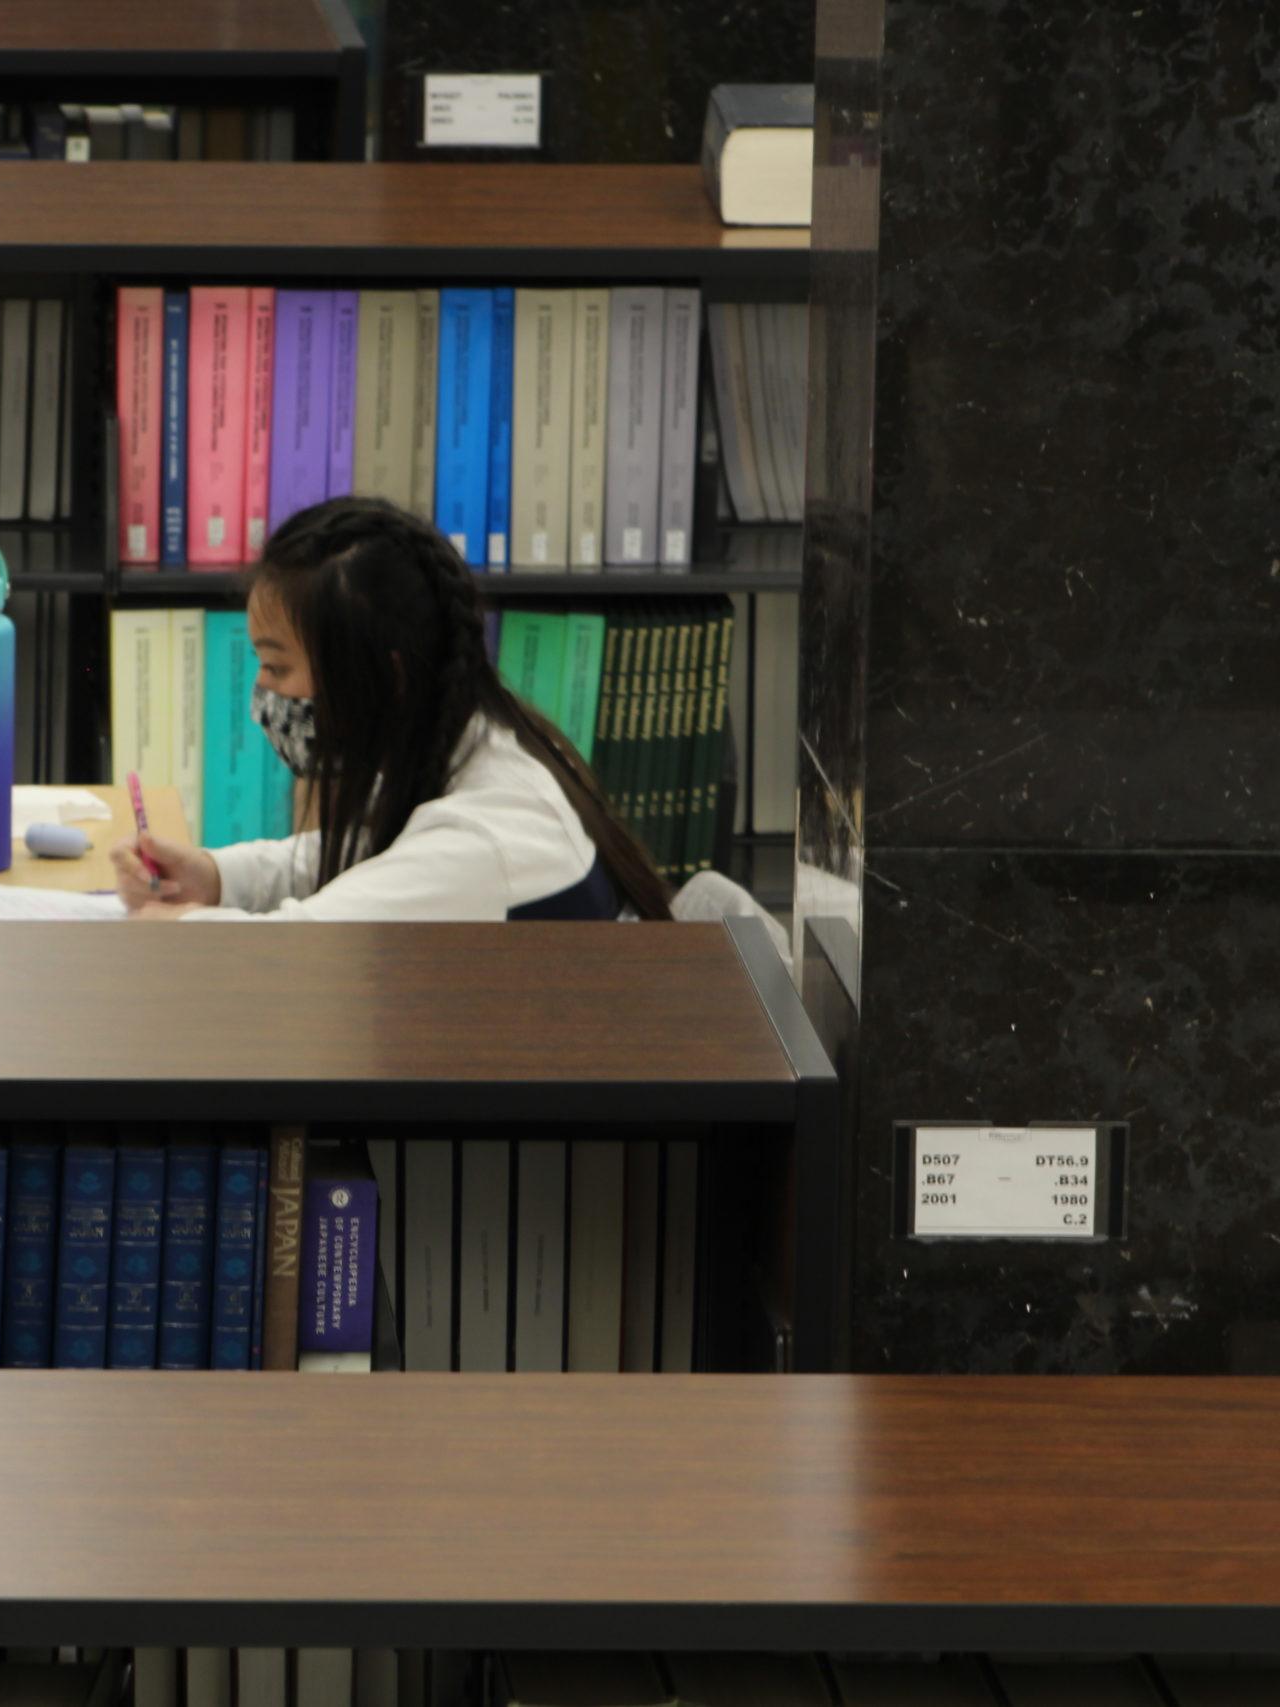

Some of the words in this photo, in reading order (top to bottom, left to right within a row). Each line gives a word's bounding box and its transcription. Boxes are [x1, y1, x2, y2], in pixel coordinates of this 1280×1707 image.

[922, 1154, 960, 1166] D507
[1035, 1155, 1089, 1167] DT56.9
[922, 1174, 955, 1186] .B67
[1054, 1175, 1088, 1187] .B34
[921, 1194, 957, 1205] 2001
[1051, 1195, 1088, 1206] 1980
[334, 1217, 344, 1231] OF
[1063, 1213, 1087, 1225] C.2
[272, 1187, 300, 1277] JAPAN
[317, 1217, 327, 1277] JAPANESE
[347, 1217, 360, 1307] ENCYCLOPEDIA
[331, 1236, 343, 1330] CONTEMPORARY
[315, 1280, 327, 1336] CULTURE
